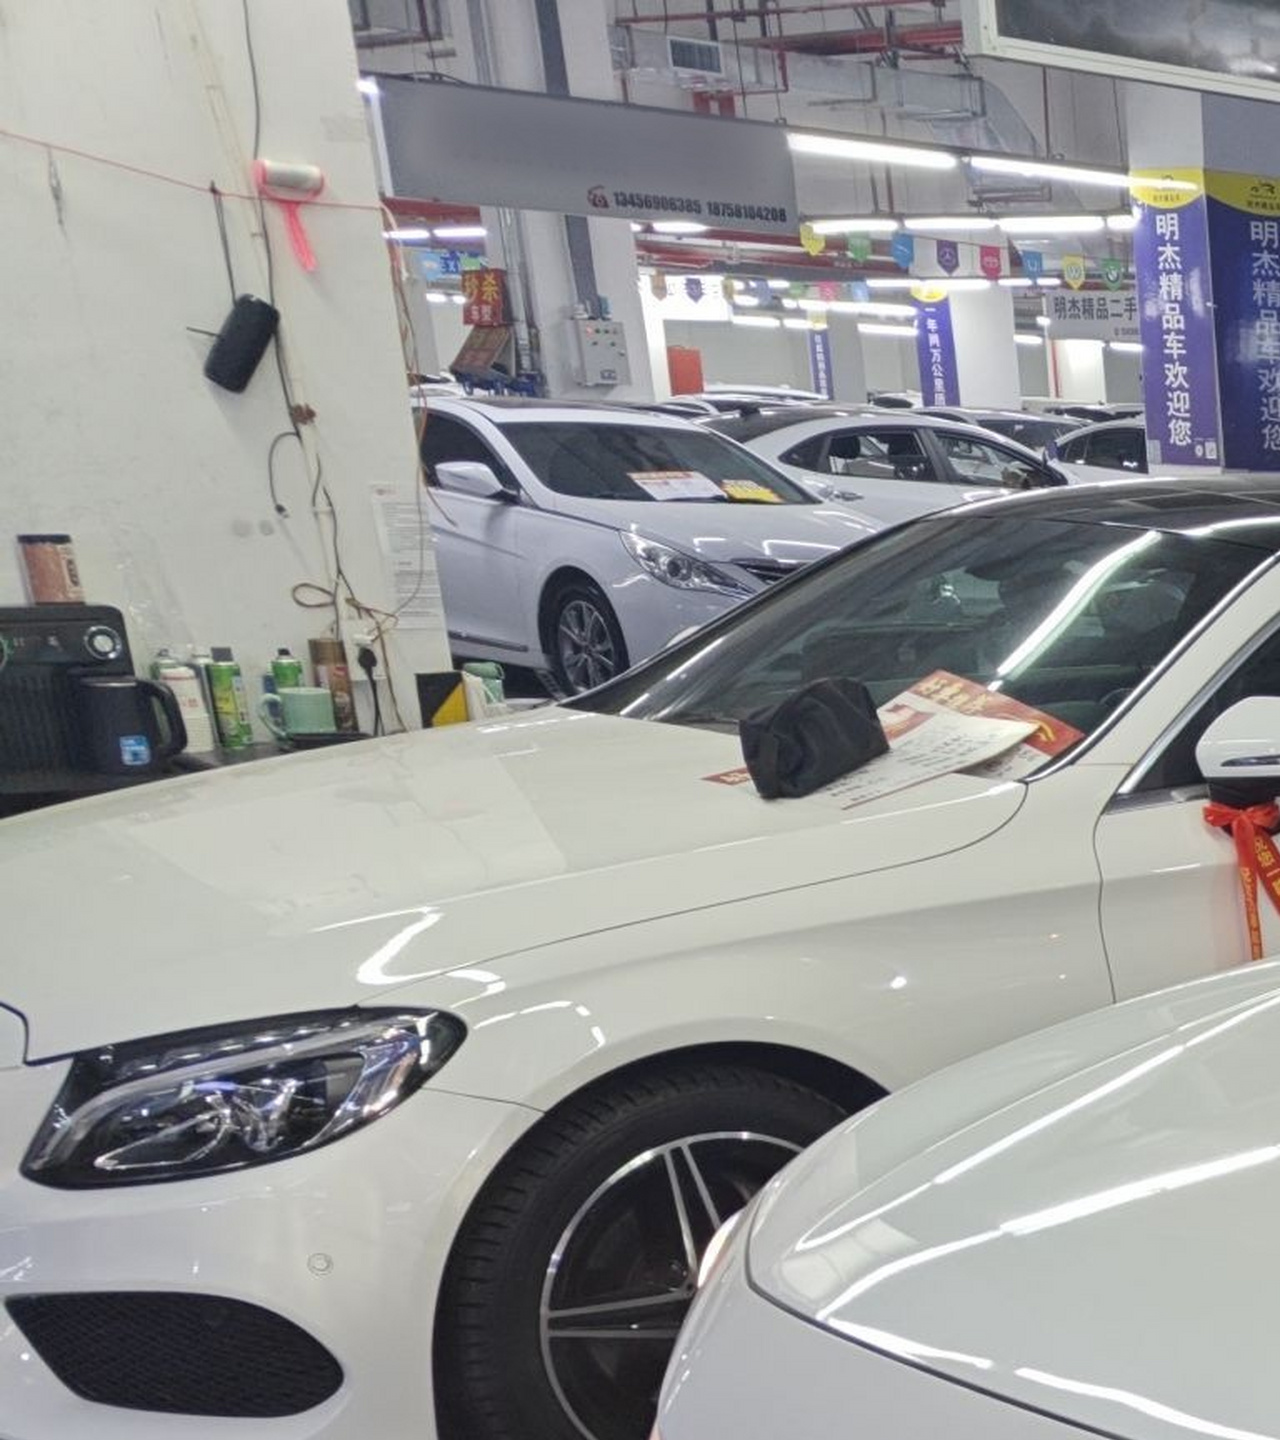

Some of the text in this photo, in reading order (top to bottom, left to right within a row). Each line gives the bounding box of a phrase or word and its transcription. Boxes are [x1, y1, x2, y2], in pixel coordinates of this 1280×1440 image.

[1155, 212, 1193, 446] 明杰精品车欢迎您
